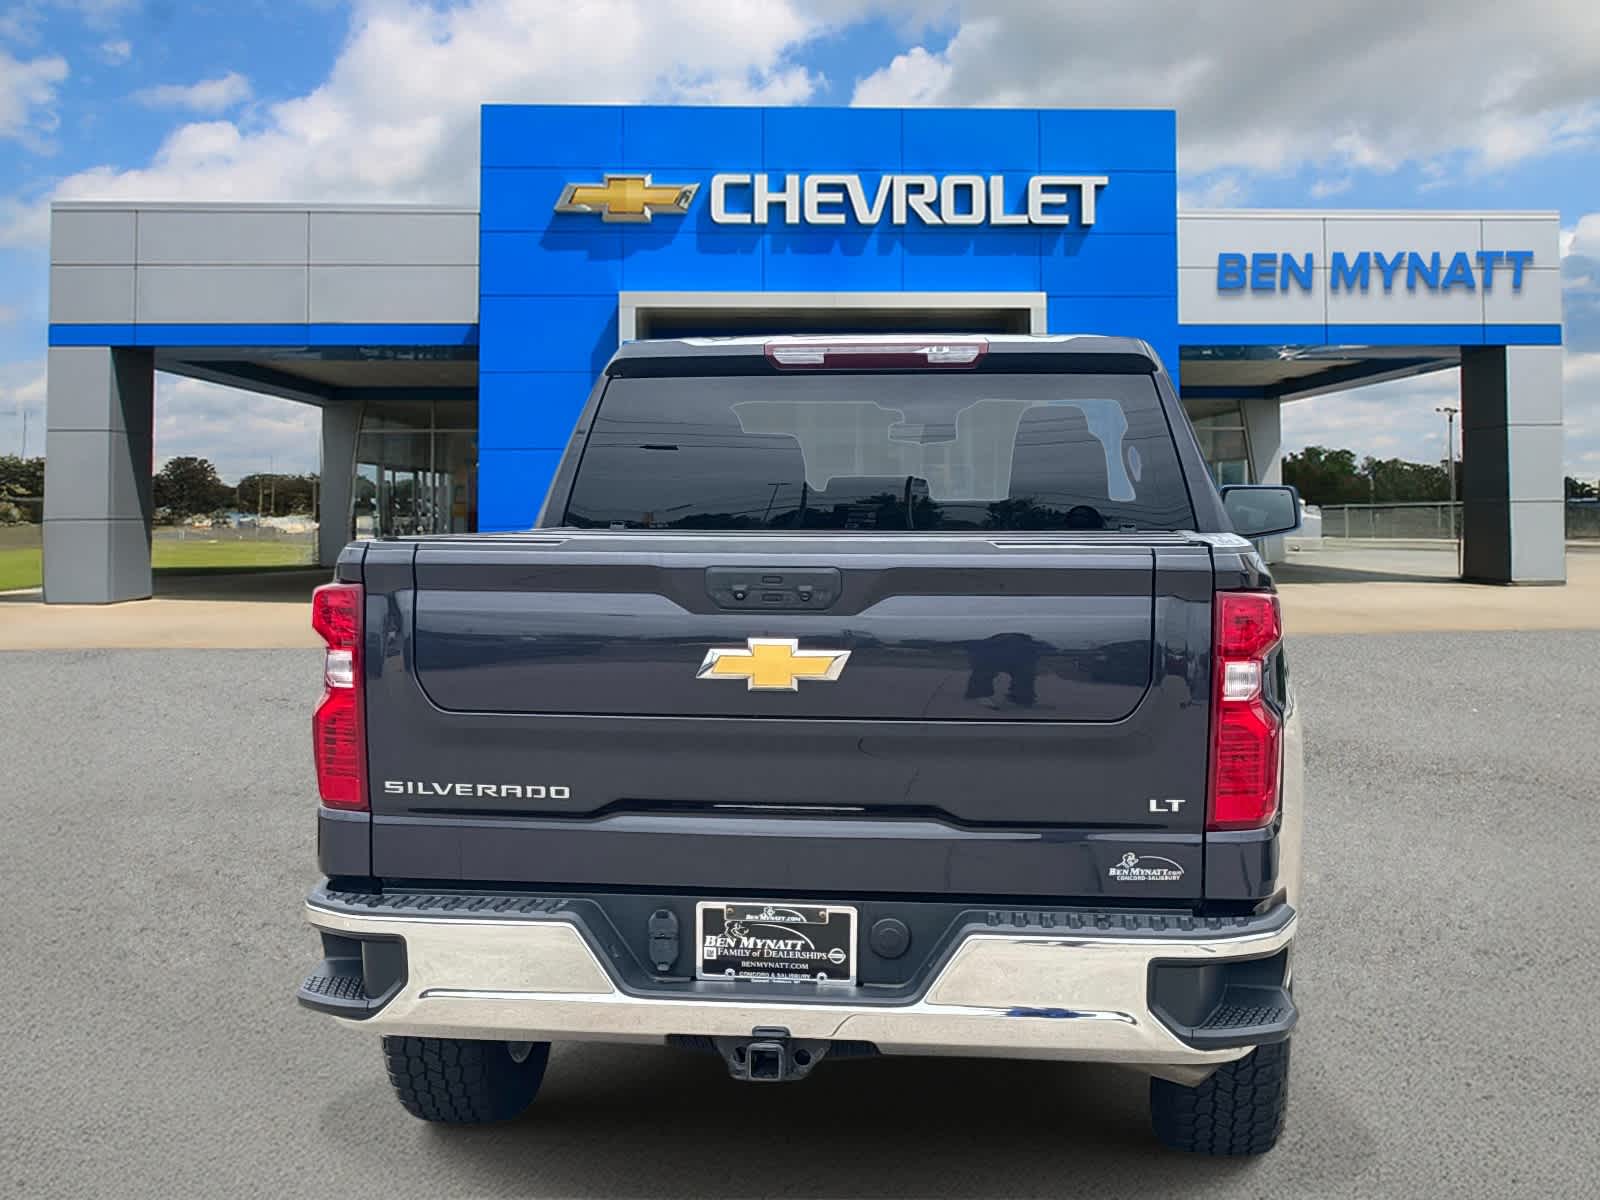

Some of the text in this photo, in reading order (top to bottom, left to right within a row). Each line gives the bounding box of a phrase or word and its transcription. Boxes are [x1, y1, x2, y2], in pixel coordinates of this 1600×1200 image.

[710, 173, 1109, 225] CHEVROLET
[1217, 250, 1534, 291] BEN MYNATT
[384, 780, 571, 799] SILVERADO
[1149, 799, 1186, 813] LT
[1108, 867, 1130, 876] BEN
[704, 935, 805, 951] BEN MYNATT
[717, 948, 750, 957] FAMILY
[763, 949, 828, 960] DEALERSHIPS
